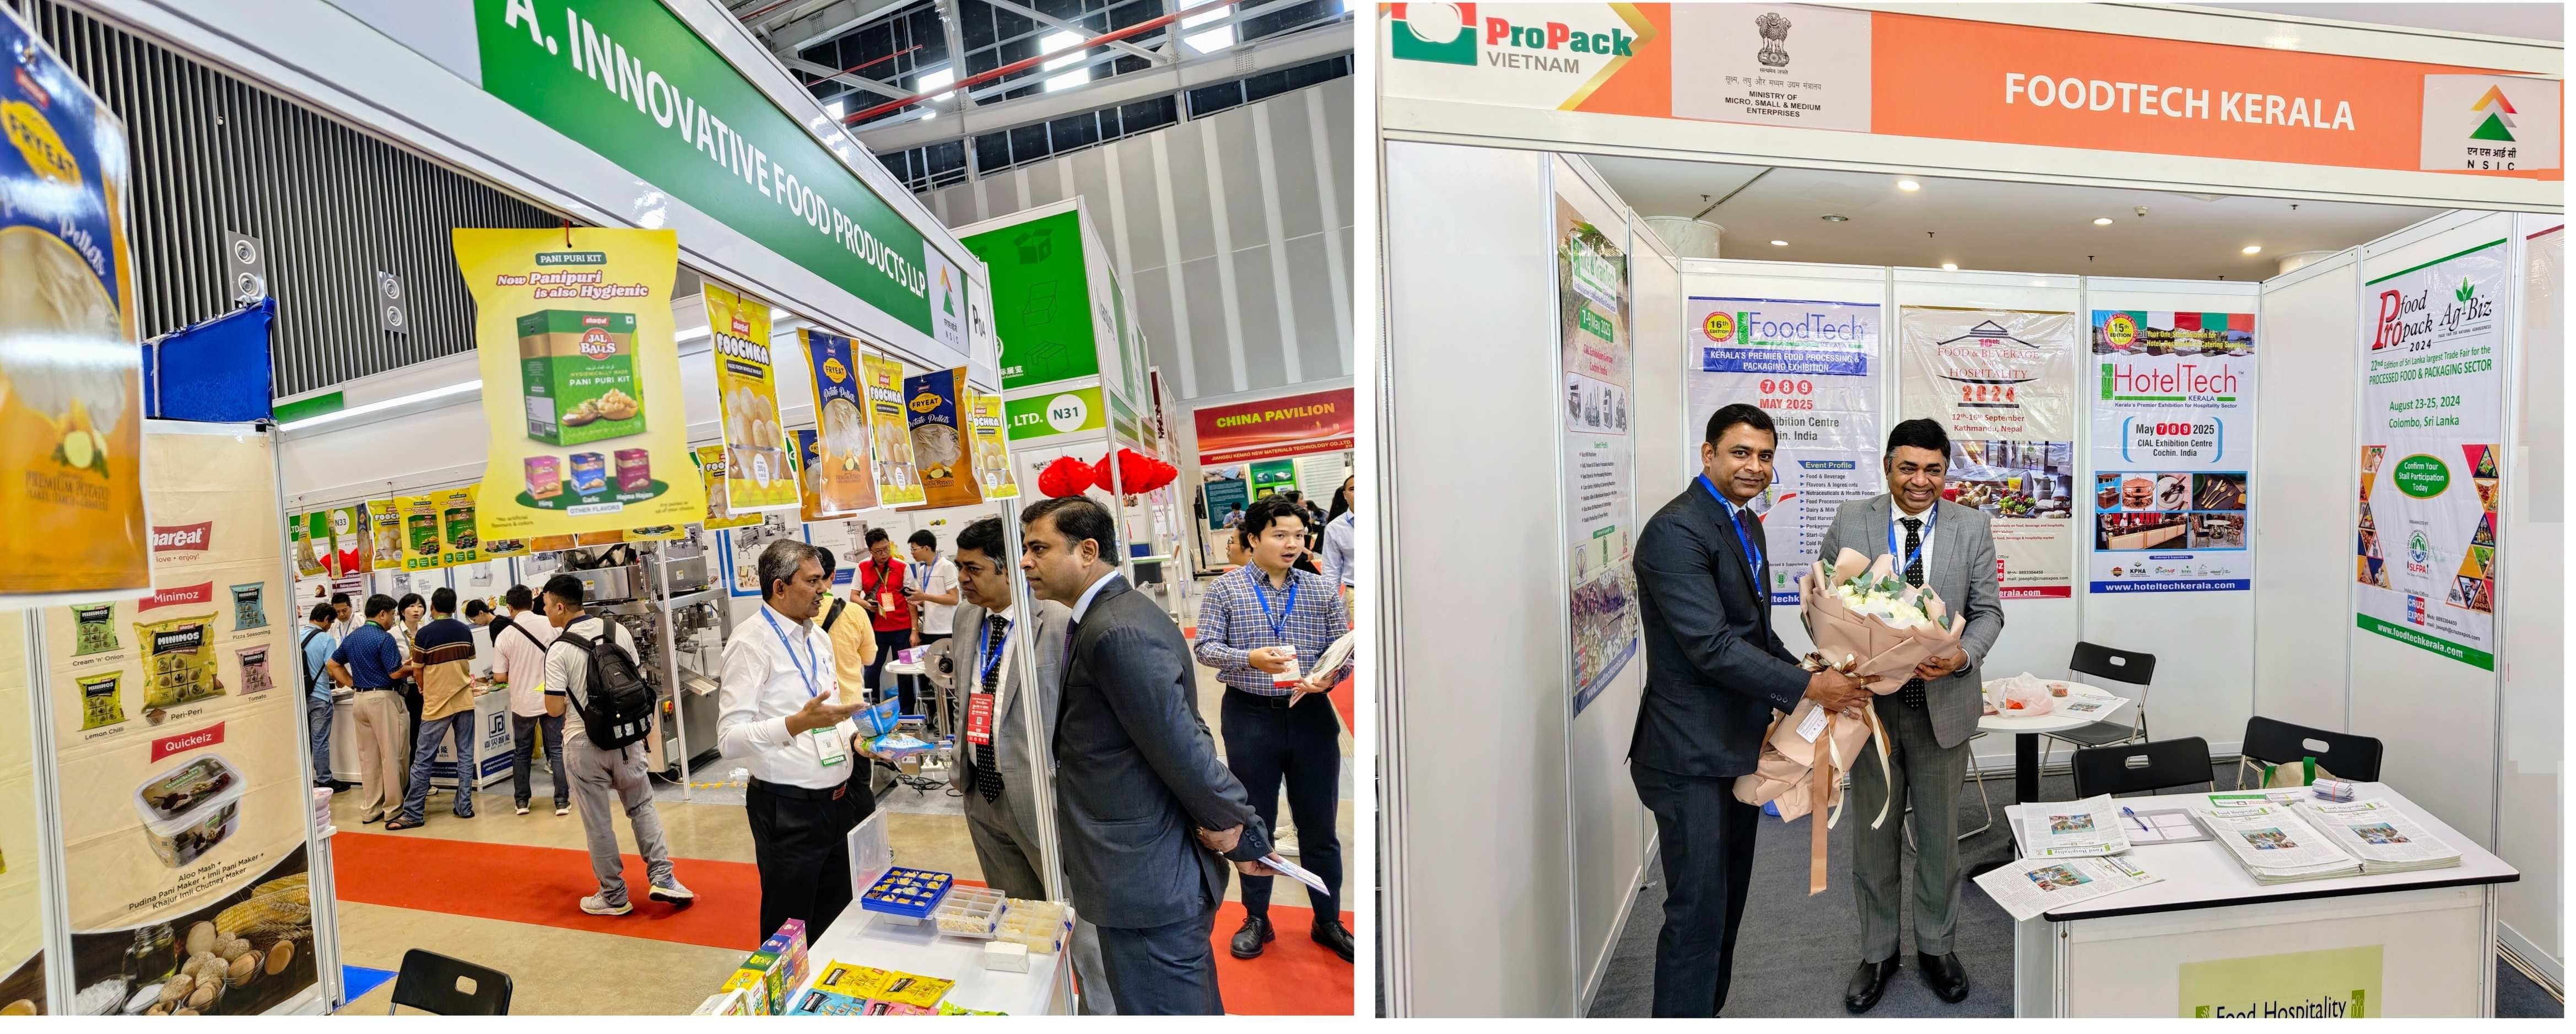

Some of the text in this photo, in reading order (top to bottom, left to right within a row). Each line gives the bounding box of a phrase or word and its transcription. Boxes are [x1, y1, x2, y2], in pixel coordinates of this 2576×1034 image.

[1486, 17, 1633, 57] ProPack
[1488, 52, 1580, 74] VIETNAM
[1755, 76, 1766, 86] और
[1749, 91, 1785, 100] MINISTRY
[2006, 73, 2354, 130] FOODTECH KERALA
[1725, 98, 1753, 106] MICRO,
[1747, 107, 1800, 117] ENTERPRISES
[567, 8, 771, 198] INNOVATIVE
[773, 161, 830, 235] FOOD
[834, 208, 908, 287] PRODUCTS
[908, 264, 927, 299] LLP
[2467, 147, 2478, 155] एन
[2493, 147, 2505, 158] आई
[2508, 147, 2516, 158] सी
[496, 270, 602, 287] Now Panipuri
[549, 283, 649, 300] also Hygienic
[2439, 295, 2492, 331] Ag-Biz
[1583, 310, 1610, 336] 7-9 May 2025
[1749, 312, 1864, 340] FoodTech
[2113, 323, 2129, 332] 15th
[716, 331, 770, 366] FOOCHKA
[2410, 340, 2431, 352] 2024
[1749, 352, 1781, 360] PREMIER
[1806, 354, 1853, 362] PROCESSING
[1937, 348, 2040, 359] FOOD BEVERAGE
[2412, 356, 2425, 364] Lanka
[2427, 353, 2443, 363] largest
[2444, 351, 2458, 360] Trade
[825, 365, 844, 375] FRYEAT
[1743, 362, 1829, 372] PACKAGING EXHIBITION
[2369, 358, 2492, 385] PROCESSED FOOD PACKAGING SECTOR
[1949, 369, 2028, 379] HOSPITALITY
[2114, 363, 2237, 393] HotelTech
[839, 386, 856, 403] Pellets
[870, 385, 903, 405] FOOCHKA
[1962, 385, 2015, 402] 2024
[912, 398, 938, 408] FRYEAT
[1760, 398, 1813, 410] MAY 2025
[2389, 395, 2460, 412] August 23-25, 2024
[927, 414, 949, 424] Pellets
[1014, 407, 1078, 427] LTD. N31
[1217, 403, 1335, 428] CHINA PAVILION
[2389, 414, 2459, 429] Colombo, Sri Lanka
[1809, 417, 1839, 427] Centre
[1795, 431, 1817, 440] India
[2136, 424, 2215, 435] May 2025
[1294, 443, 1329, 451] TECHNOLOGY
[2411, 473, 2444, 482] Participation
[2413, 483, 2428, 493] Today
[179, 553, 199, 562] enjoy!
[2410, 563, 2426, 573] SLFPA
[2105, 582, 2235, 591] www.hoteltechkerala.com
[154, 591, 198, 604] Minimoz
[2408, 599, 2424, 610] CRUZ
[2408, 611, 2424, 621] EXPOS
[158, 632, 199, 645] MINIMOS
[246, 629, 271, 638] Seasoning
[2378, 623, 2463, 658] www.foodtechkerala.com
[73, 658, 94, 666] Cream
[88, 682, 114, 691] MINIMOS
[248, 693, 267, 702] Tomato
[171, 708, 202, 720] Peri-Peri
[85, 730, 107, 740] Lemon
[165, 732, 212, 751] Quickeiz
[179, 863, 215, 882] Aloo Mash
[128, 854, 258, 910] Pudina Pani Maker Imli Pani Maker
[153, 868, 246, 910] Khajur Chutney Maker
